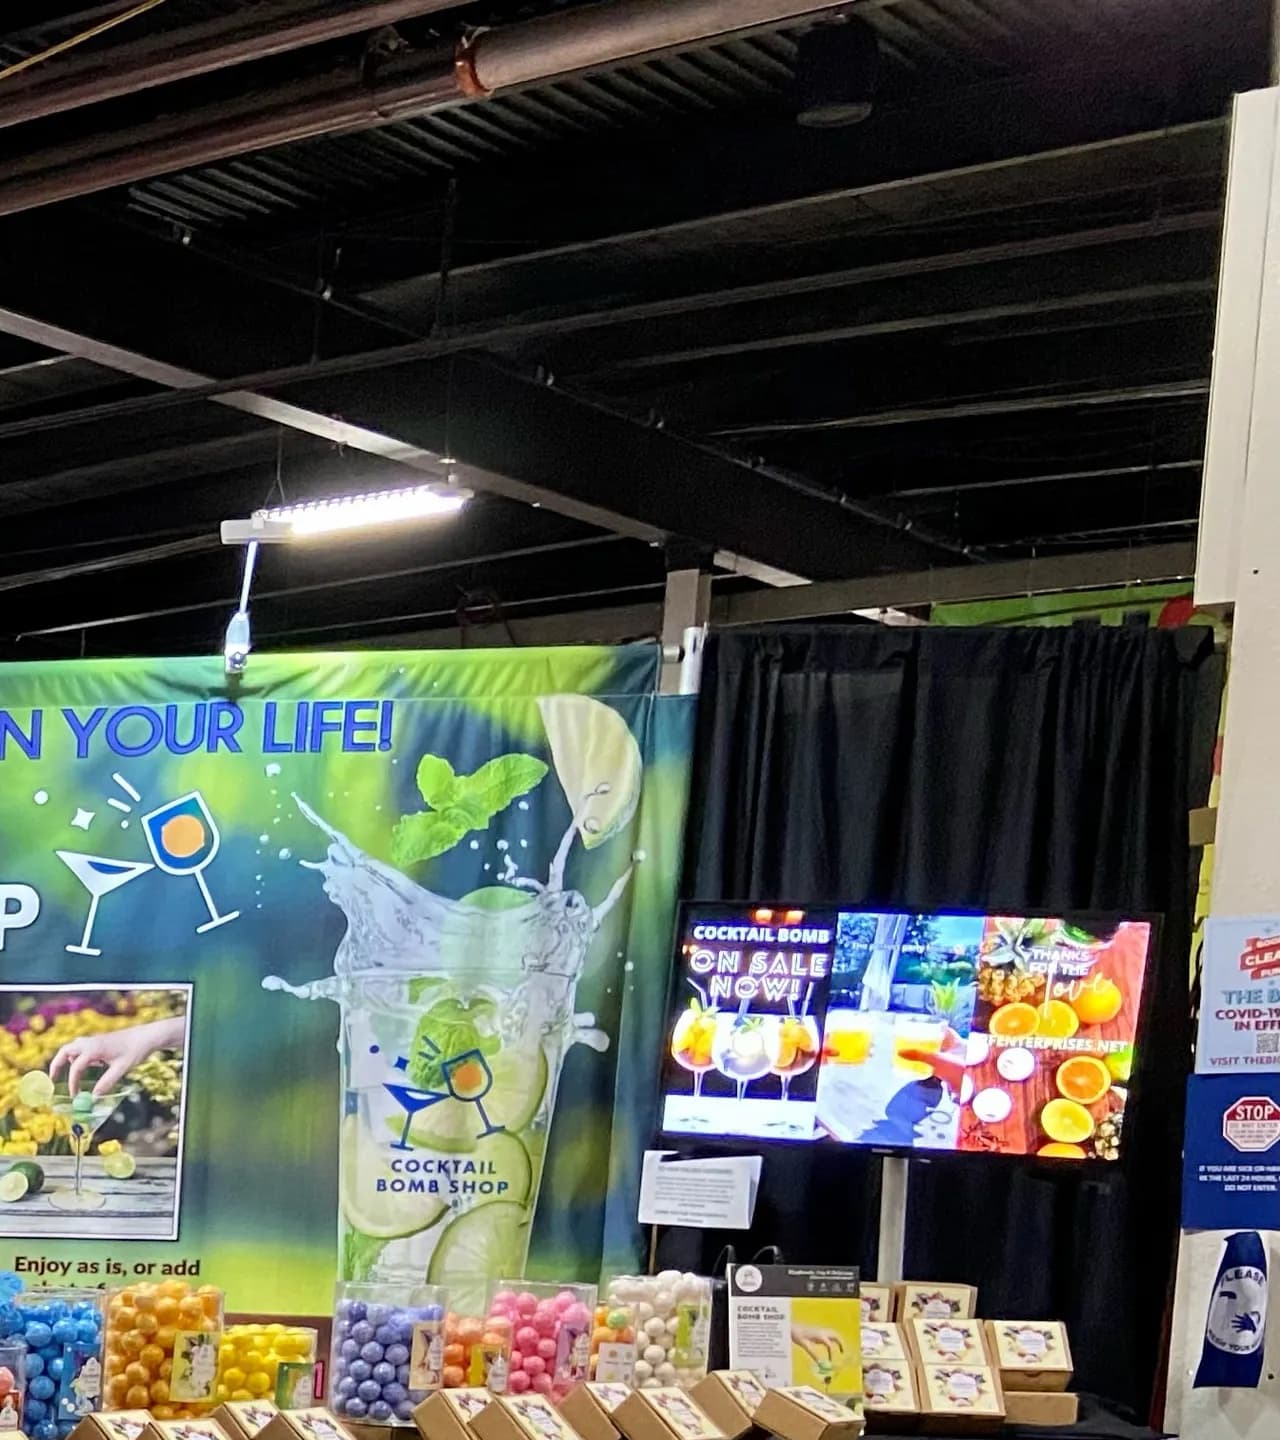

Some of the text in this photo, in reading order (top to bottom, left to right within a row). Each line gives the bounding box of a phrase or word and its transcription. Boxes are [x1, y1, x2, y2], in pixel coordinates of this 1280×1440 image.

[61, 700, 244, 758] YOUR
[262, 700, 393, 754] LIFE!
[693, 926, 830, 944] COCKTAIL BOMB
[690, 949, 828, 977] ON SALE
[1031, 949, 1090, 962] THANKS
[1061, 963, 1089, 976] THE
[710, 974, 801, 1001] NOW!
[1234, 1020, 1251, 1032] IN
[1209, 1056, 1240, 1067] VISIT
[1235, 1104, 1274, 1121] STOP
[391, 1159, 496, 1174] COCKTAIL
[376, 1178, 509, 1194] BOMB SHOP
[14, 1256, 201, 1277] Enjoy as is, or add
